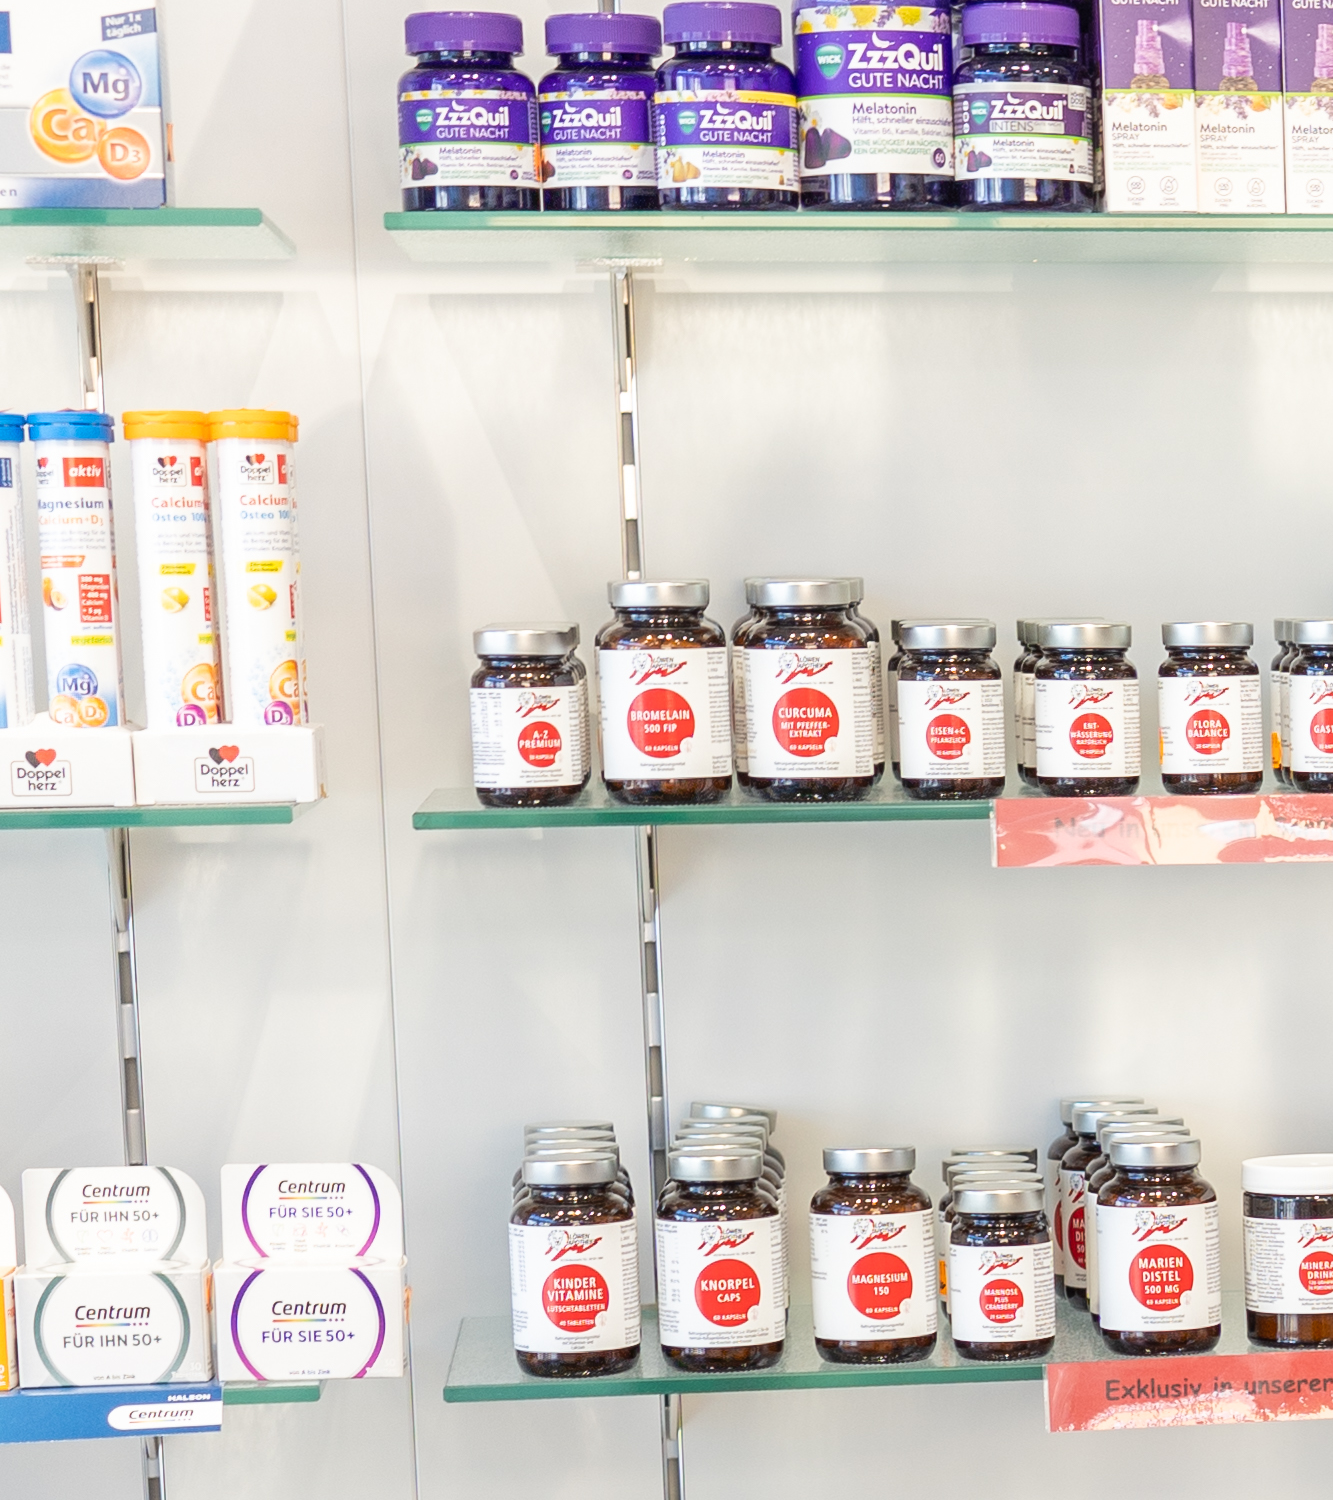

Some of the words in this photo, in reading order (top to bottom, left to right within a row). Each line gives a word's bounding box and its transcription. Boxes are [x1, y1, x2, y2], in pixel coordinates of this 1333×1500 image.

[818, 55, 842, 64] WICK
[848, 43, 944, 70] ZzzQuil
[82, 72, 131, 101] Mg
[849, 74, 894, 88] GUTE
[897, 74, 944, 90] NACHT
[852, 103, 916, 115] Melatonin
[42, 108, 98, 142] Ca
[630, 709, 690, 722] BROMELAIN
[778, 707, 832, 719] CURCUMA
[644, 724, 661, 734] 500
[664, 723, 678, 733] FIP
[1193, 720, 1222, 730] FLORA
[1187, 729, 1229, 738] BALANCE
[17, 767, 65, 784] Doppel
[200, 764, 248, 780] Doppel
[28, 778, 57, 792] herz
[211, 775, 240, 789] herz
[1138, 1257, 1184, 1269] MARIEN
[553, 1276, 597, 1289] KINDER
[1142, 1271, 1180, 1283] DISTEL
[700, 1278, 755, 1292] KNORPEL
[547, 1288, 603, 1302] VITAMINE
[717, 1292, 740, 1303] CAPS
[75, 1305, 150, 1320] Centrum
[271, 1301, 346, 1316] Centrum
[63, 1333, 94, 1348] FÜR
[100, 1335, 128, 1347] IHN
[132, 1333, 162, 1346] 50+
[262, 1329, 293, 1343] FÜR
[299, 1330, 321, 1342] SIE
[326, 1330, 355, 1342] 50+
[1105, 1378, 1201, 1401] Exklusiv
[1214, 1378, 1232, 1398] in
[1244, 1375, 1333, 1396] unserer
